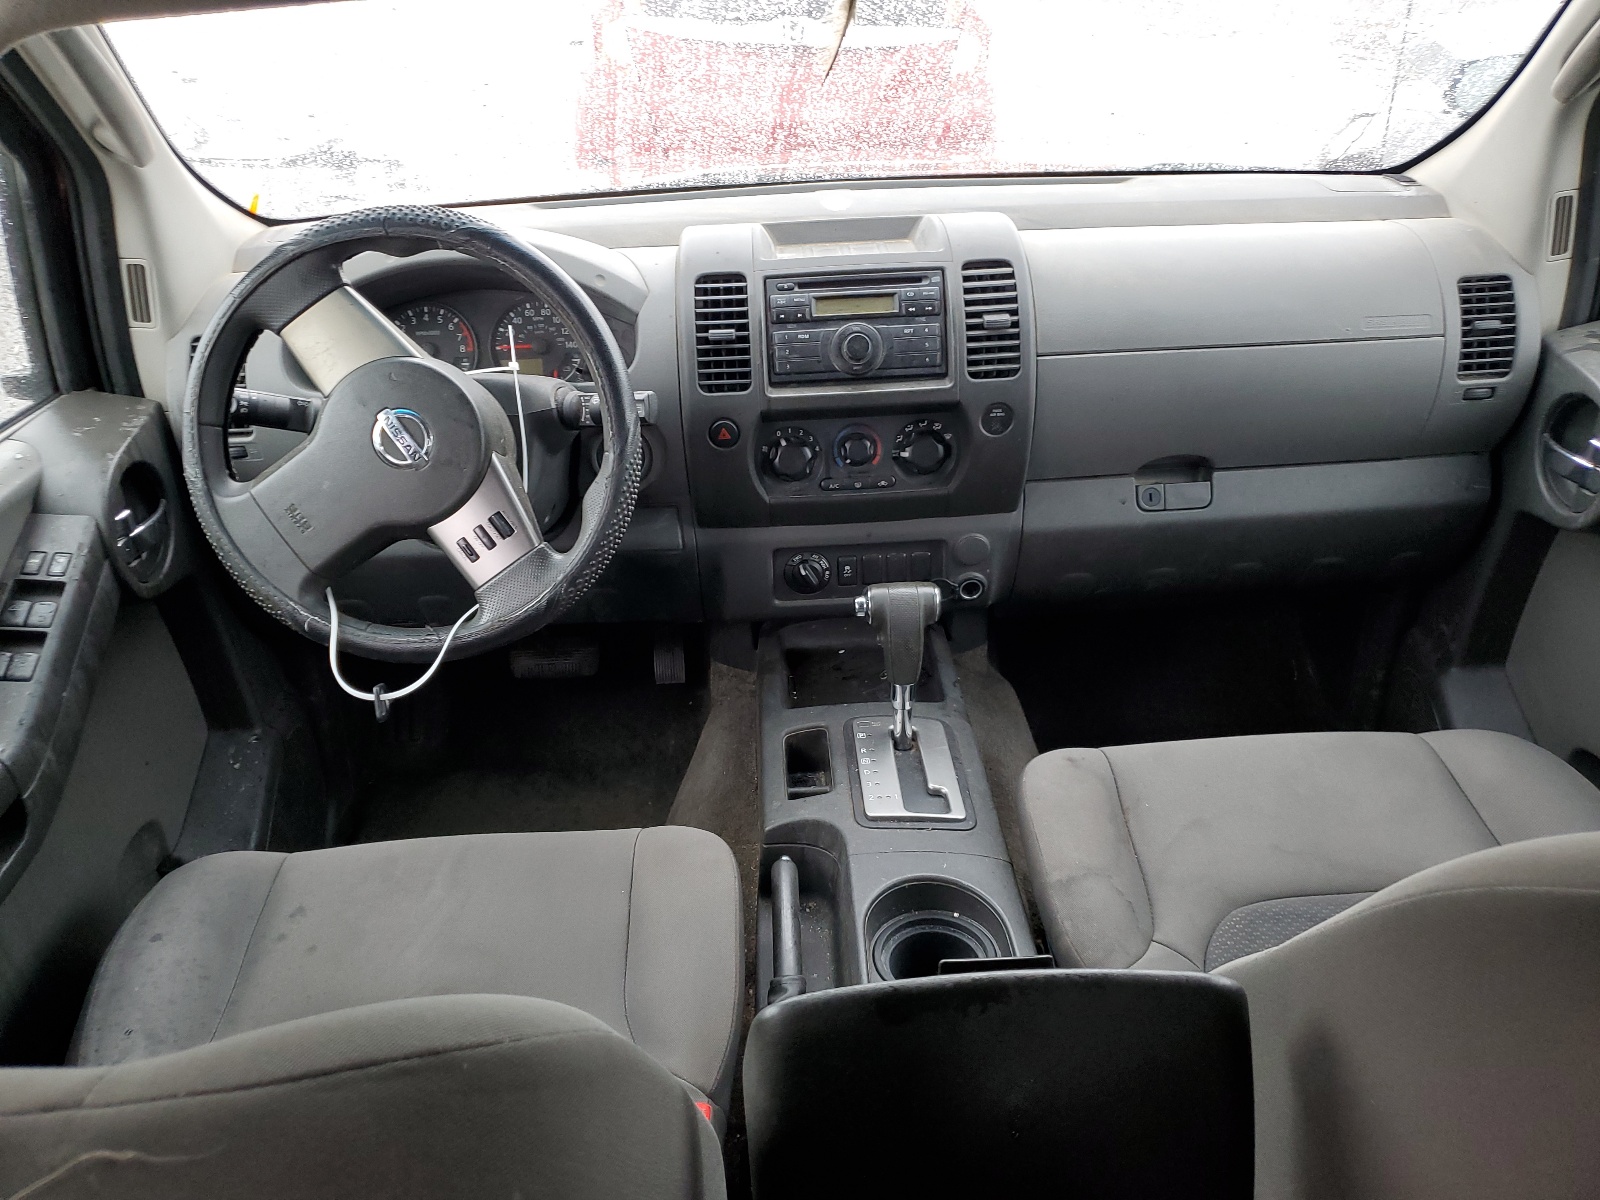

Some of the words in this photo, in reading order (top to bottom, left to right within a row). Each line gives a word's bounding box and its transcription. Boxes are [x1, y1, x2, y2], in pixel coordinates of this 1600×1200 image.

[524, 309, 535, 317] 60
[540, 308, 552, 316] 80
[411, 317, 417, 325] 3
[437, 315, 443, 324] 5
[448, 322, 455, 331] 6
[456, 333, 462, 341] 7
[459, 344, 466, 353] 8
[384, 415, 422, 462] NISSAN
